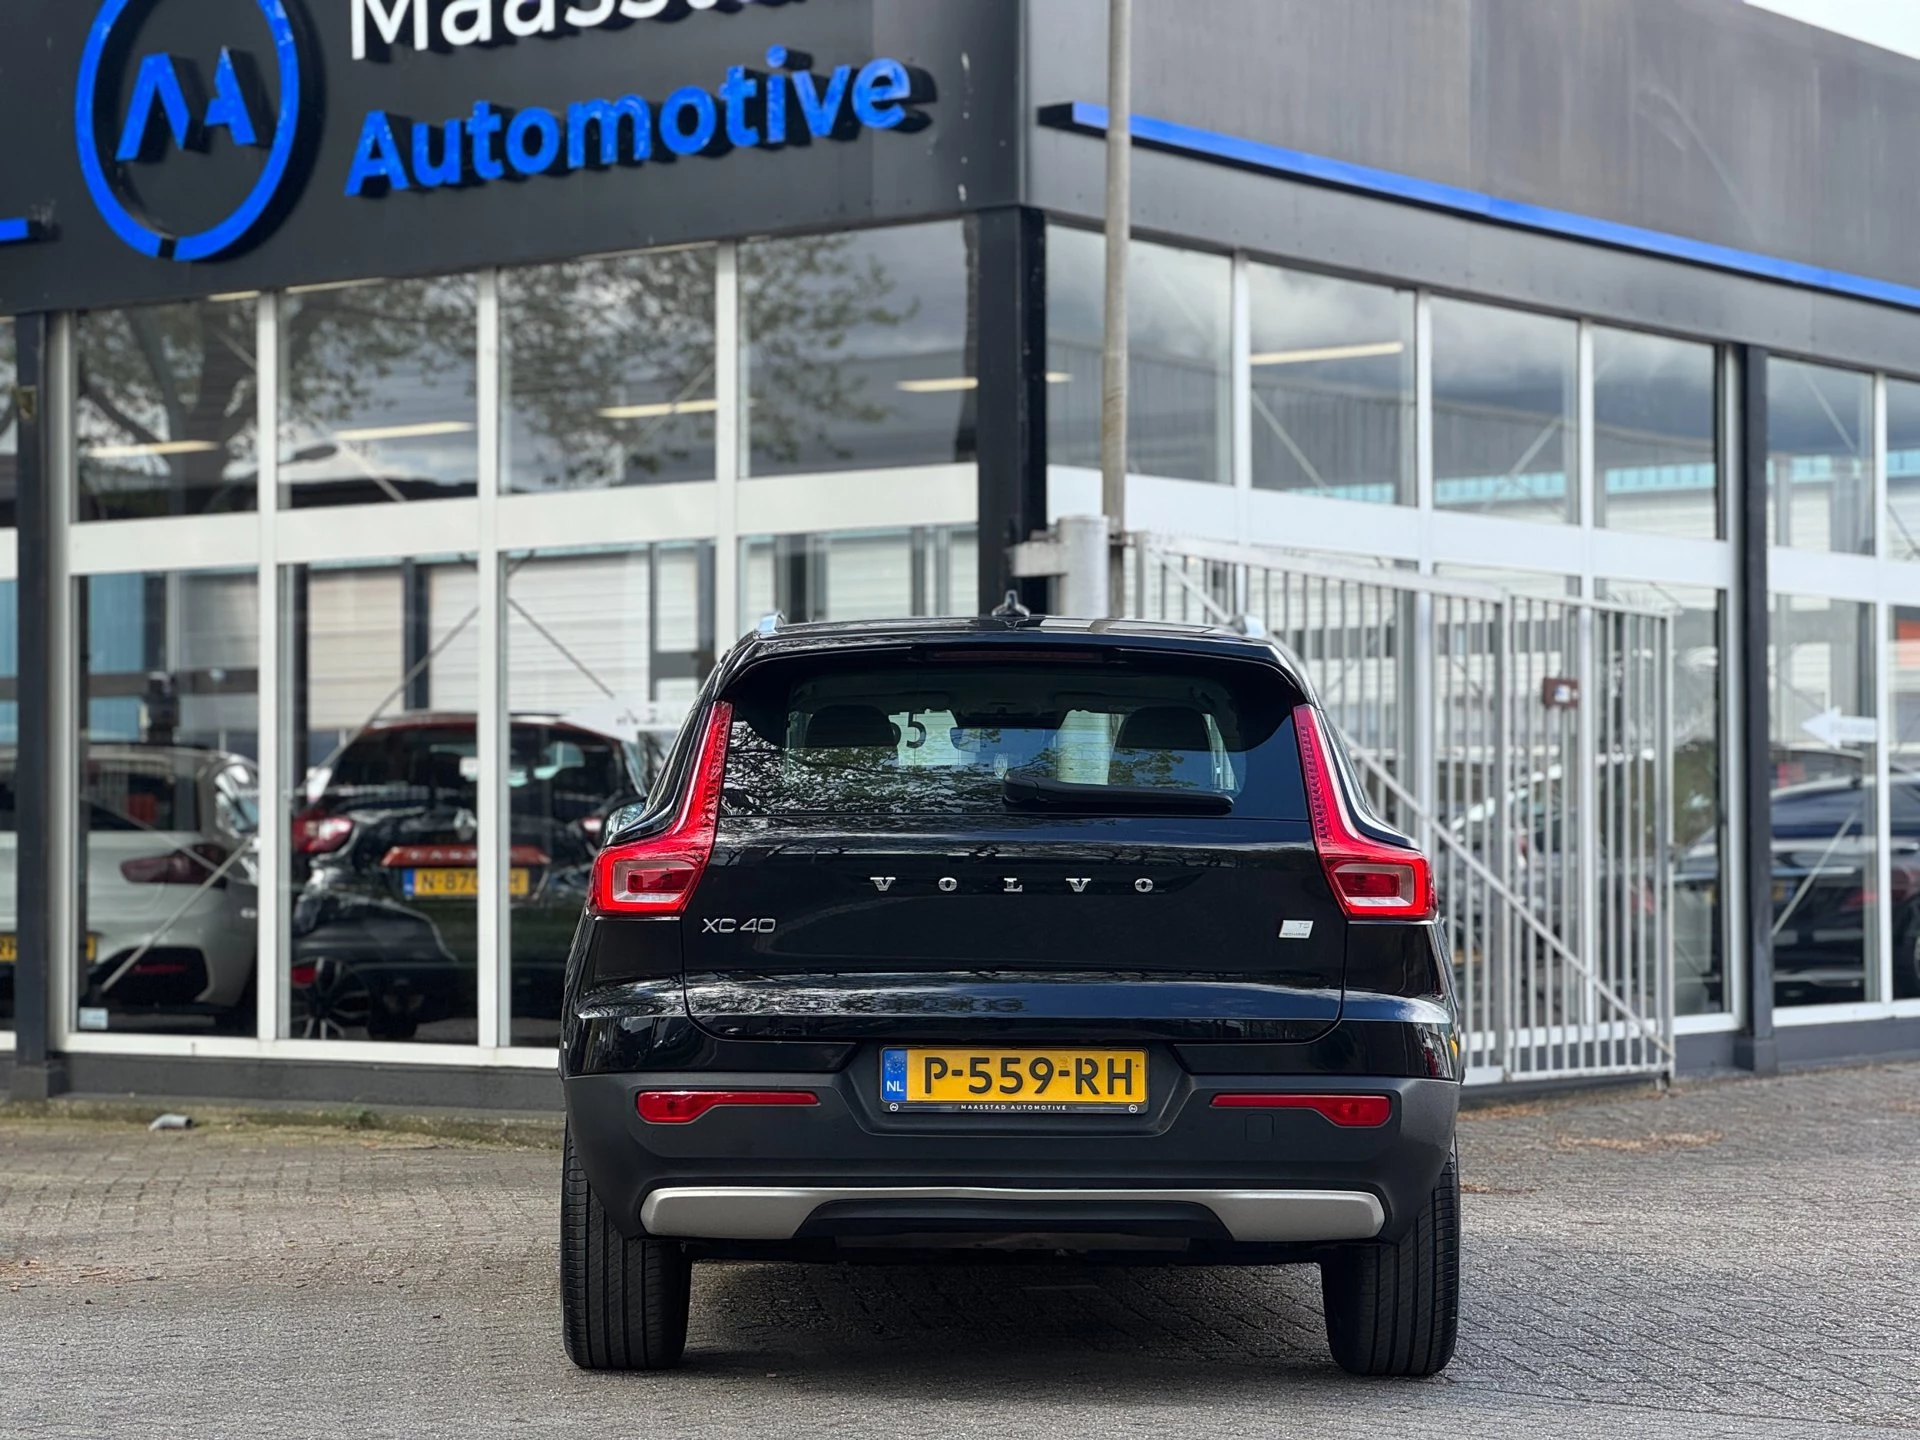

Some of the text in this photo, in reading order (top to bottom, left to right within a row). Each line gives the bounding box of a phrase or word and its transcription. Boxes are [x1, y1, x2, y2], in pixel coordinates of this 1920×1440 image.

[345, 45, 911, 195] Automotive
[870, 877, 1154, 893] VOLVO
[701, 918, 776, 934] XC40
[924, 1057, 1132, 1095] P-559-RH
[887, 1080, 904, 1092] NL
